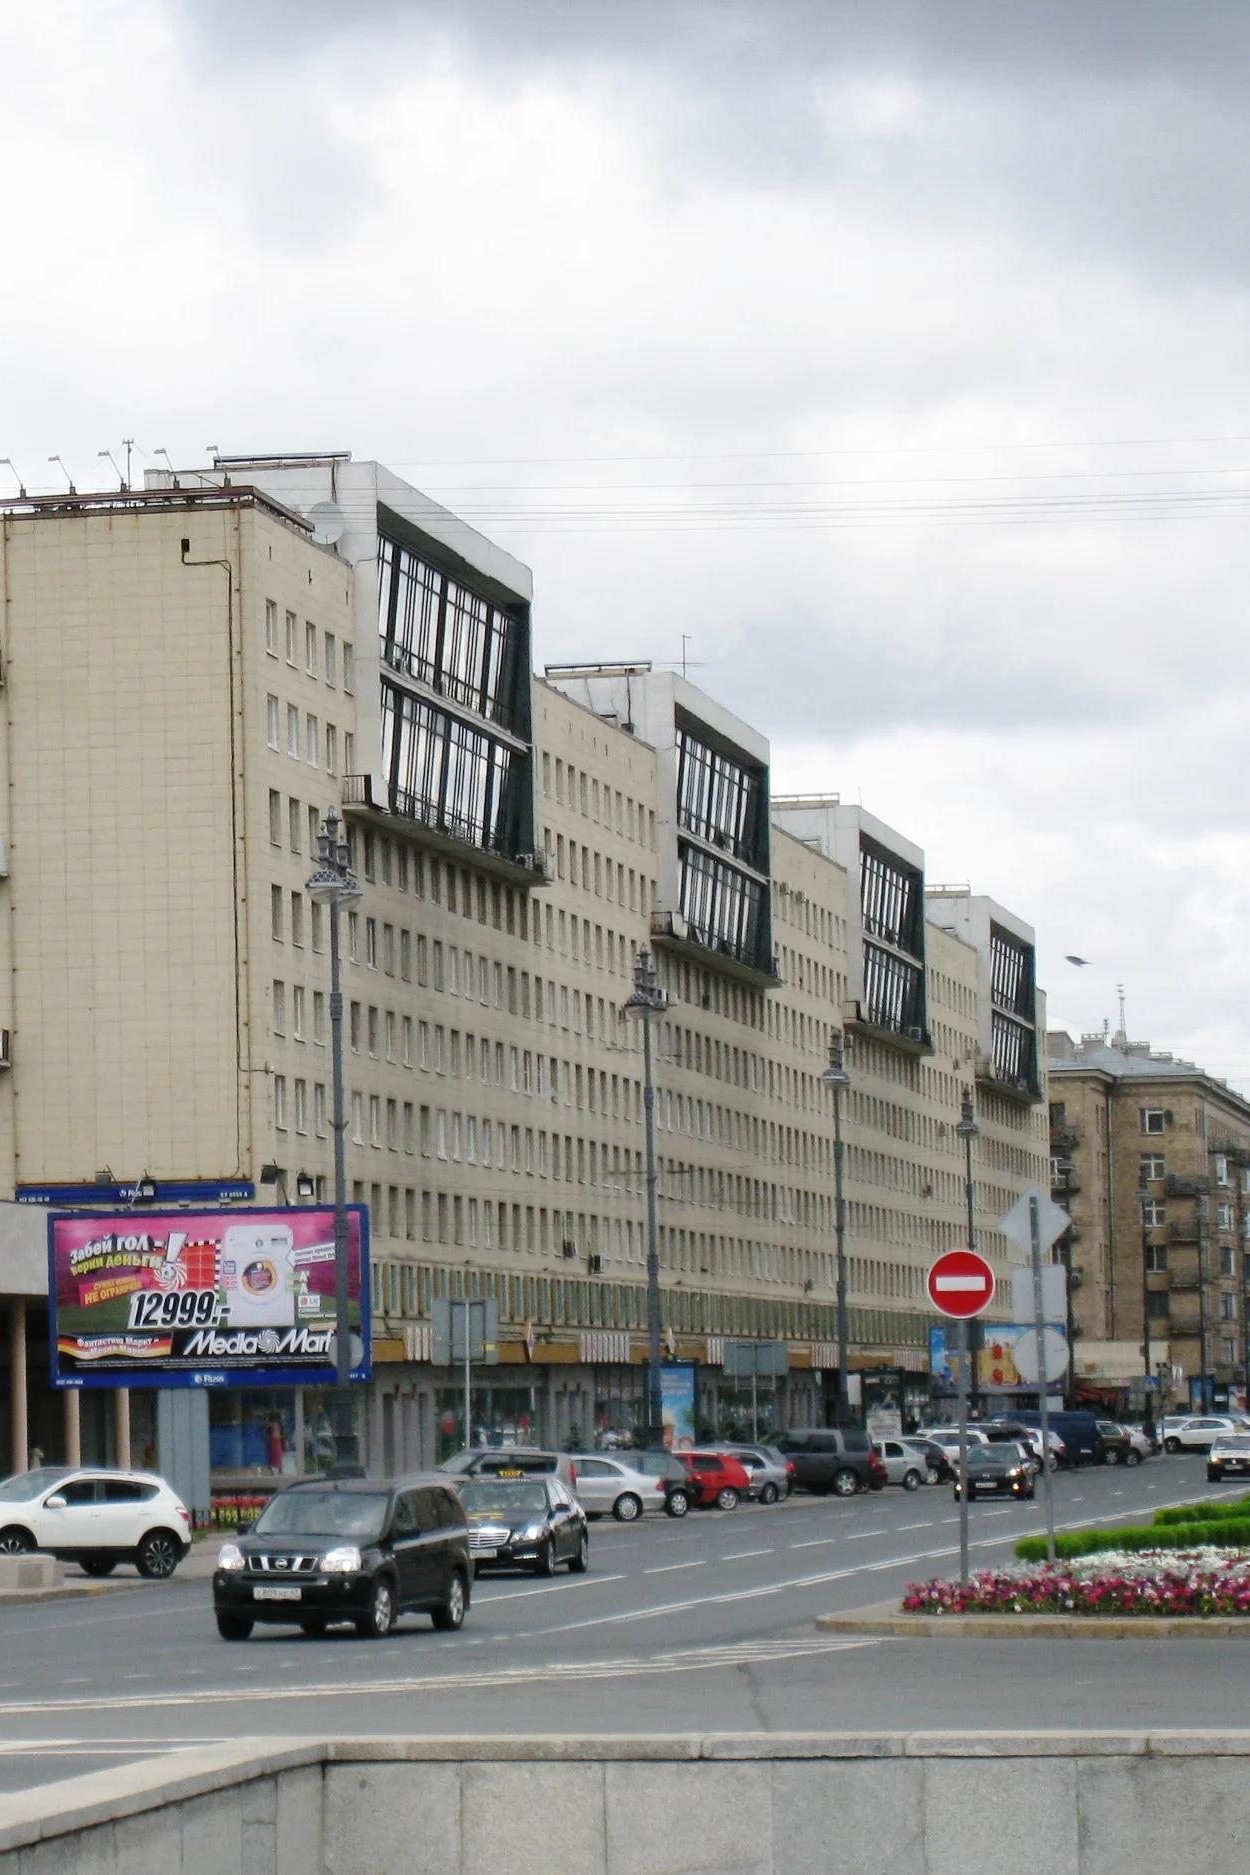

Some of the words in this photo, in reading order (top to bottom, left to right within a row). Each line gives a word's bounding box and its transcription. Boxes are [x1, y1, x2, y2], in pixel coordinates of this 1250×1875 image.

[70, 1233, 113, 1265] Забей
[117, 1234, 149, 1252] гол
[70, 1257, 104, 1276] верни
[85, 1291, 98, 1305] НЕ
[183, 1329, 258, 1355] Media
[203, 1374, 225, 1383] Russ
